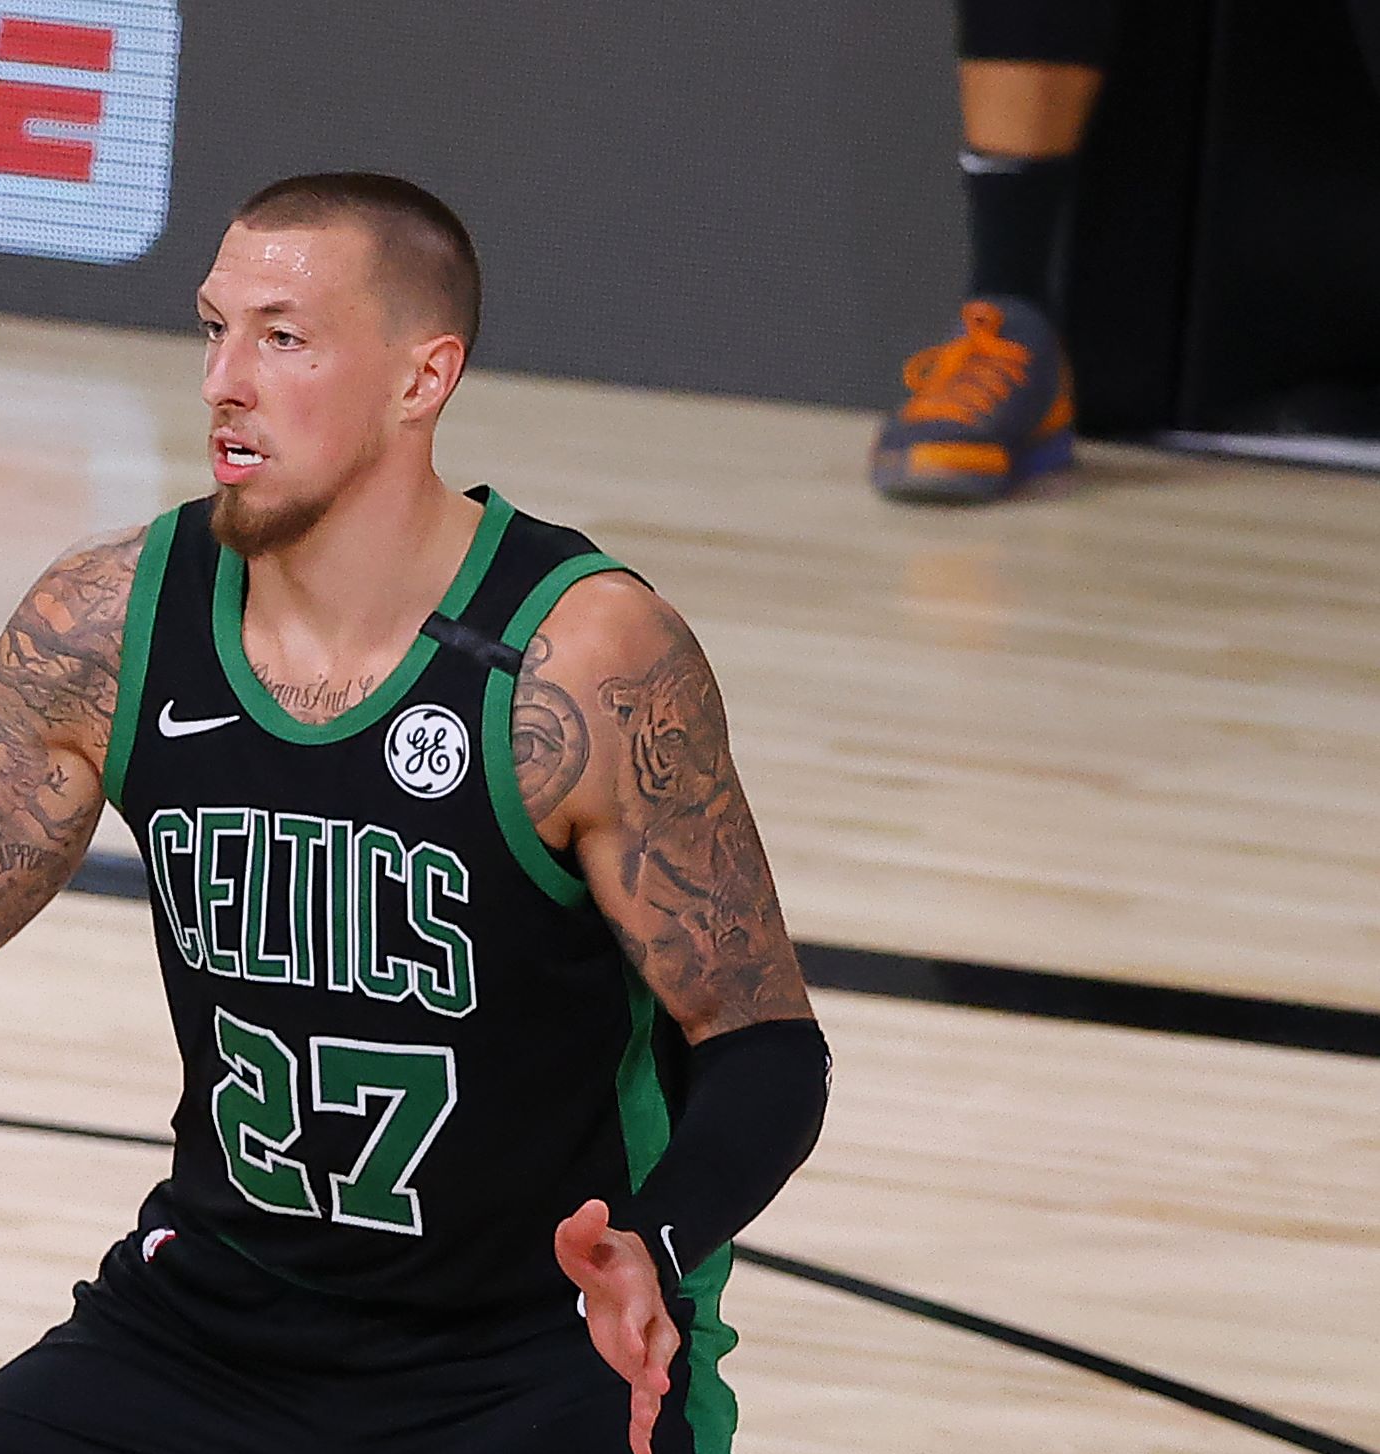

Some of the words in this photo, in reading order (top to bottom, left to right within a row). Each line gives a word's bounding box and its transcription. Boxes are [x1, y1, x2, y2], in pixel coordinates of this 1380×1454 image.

[405, 726, 451, 776] GE
[148, 806, 477, 1018] CELTICS
[211, 1005, 459, 1236] 27
